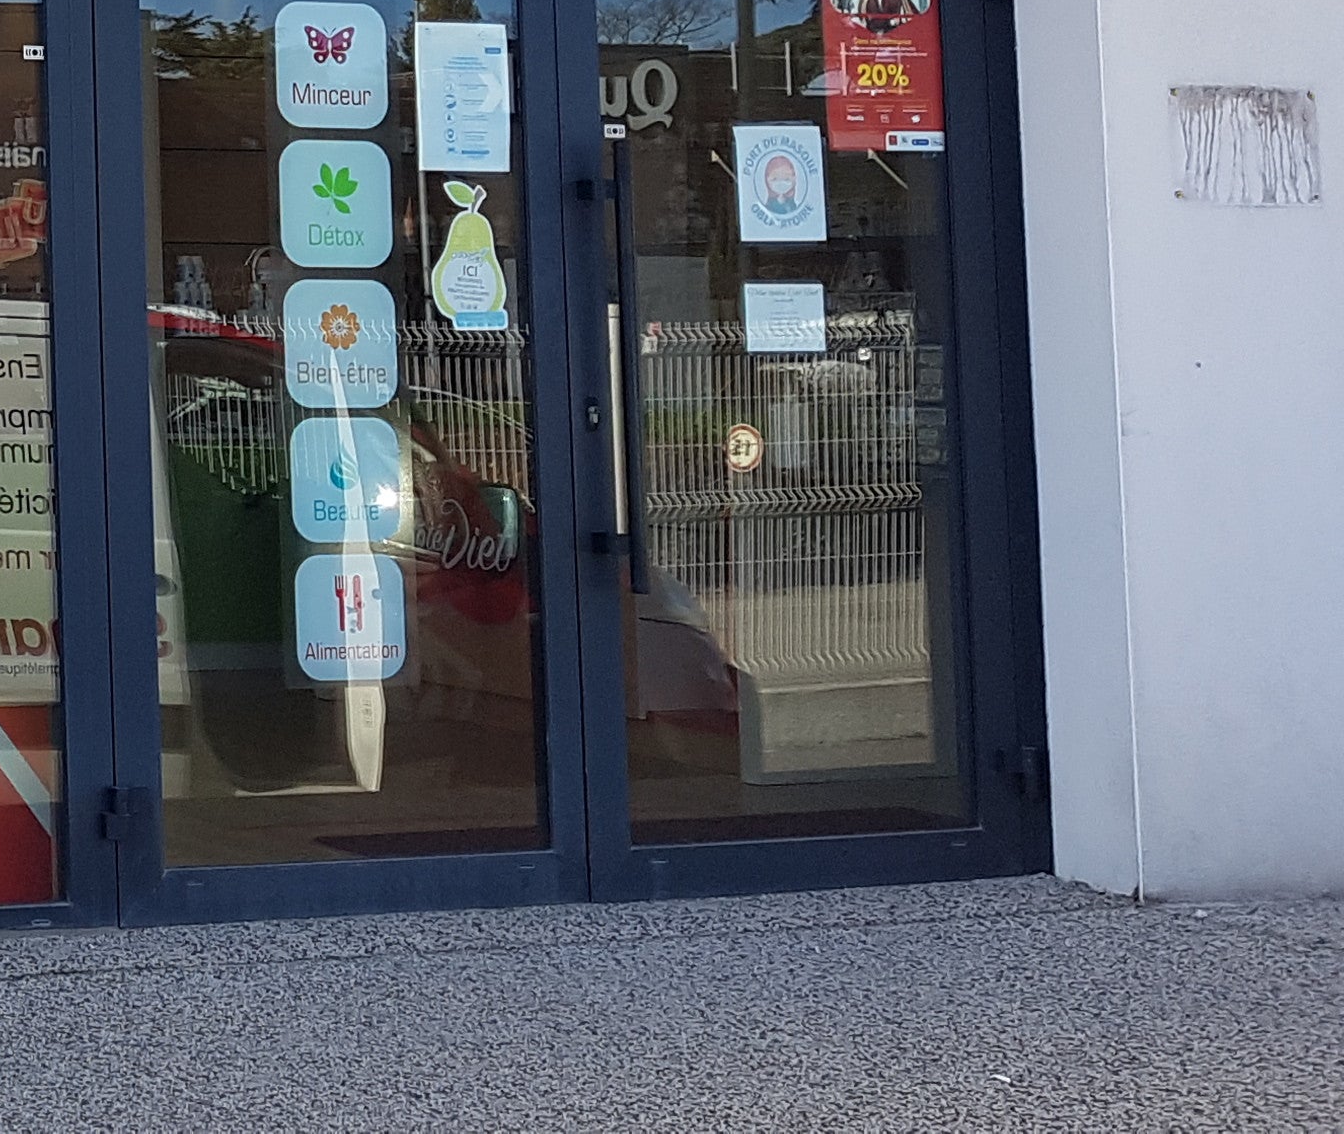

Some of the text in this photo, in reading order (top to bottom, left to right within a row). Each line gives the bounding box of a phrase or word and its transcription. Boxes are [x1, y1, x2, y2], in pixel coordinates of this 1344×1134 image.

[291, 82, 372, 106] Minceur
[308, 223, 364, 246] Détox
[296, 362, 387, 384] Bien-être
[304, 641, 400, 661] Alimentation
